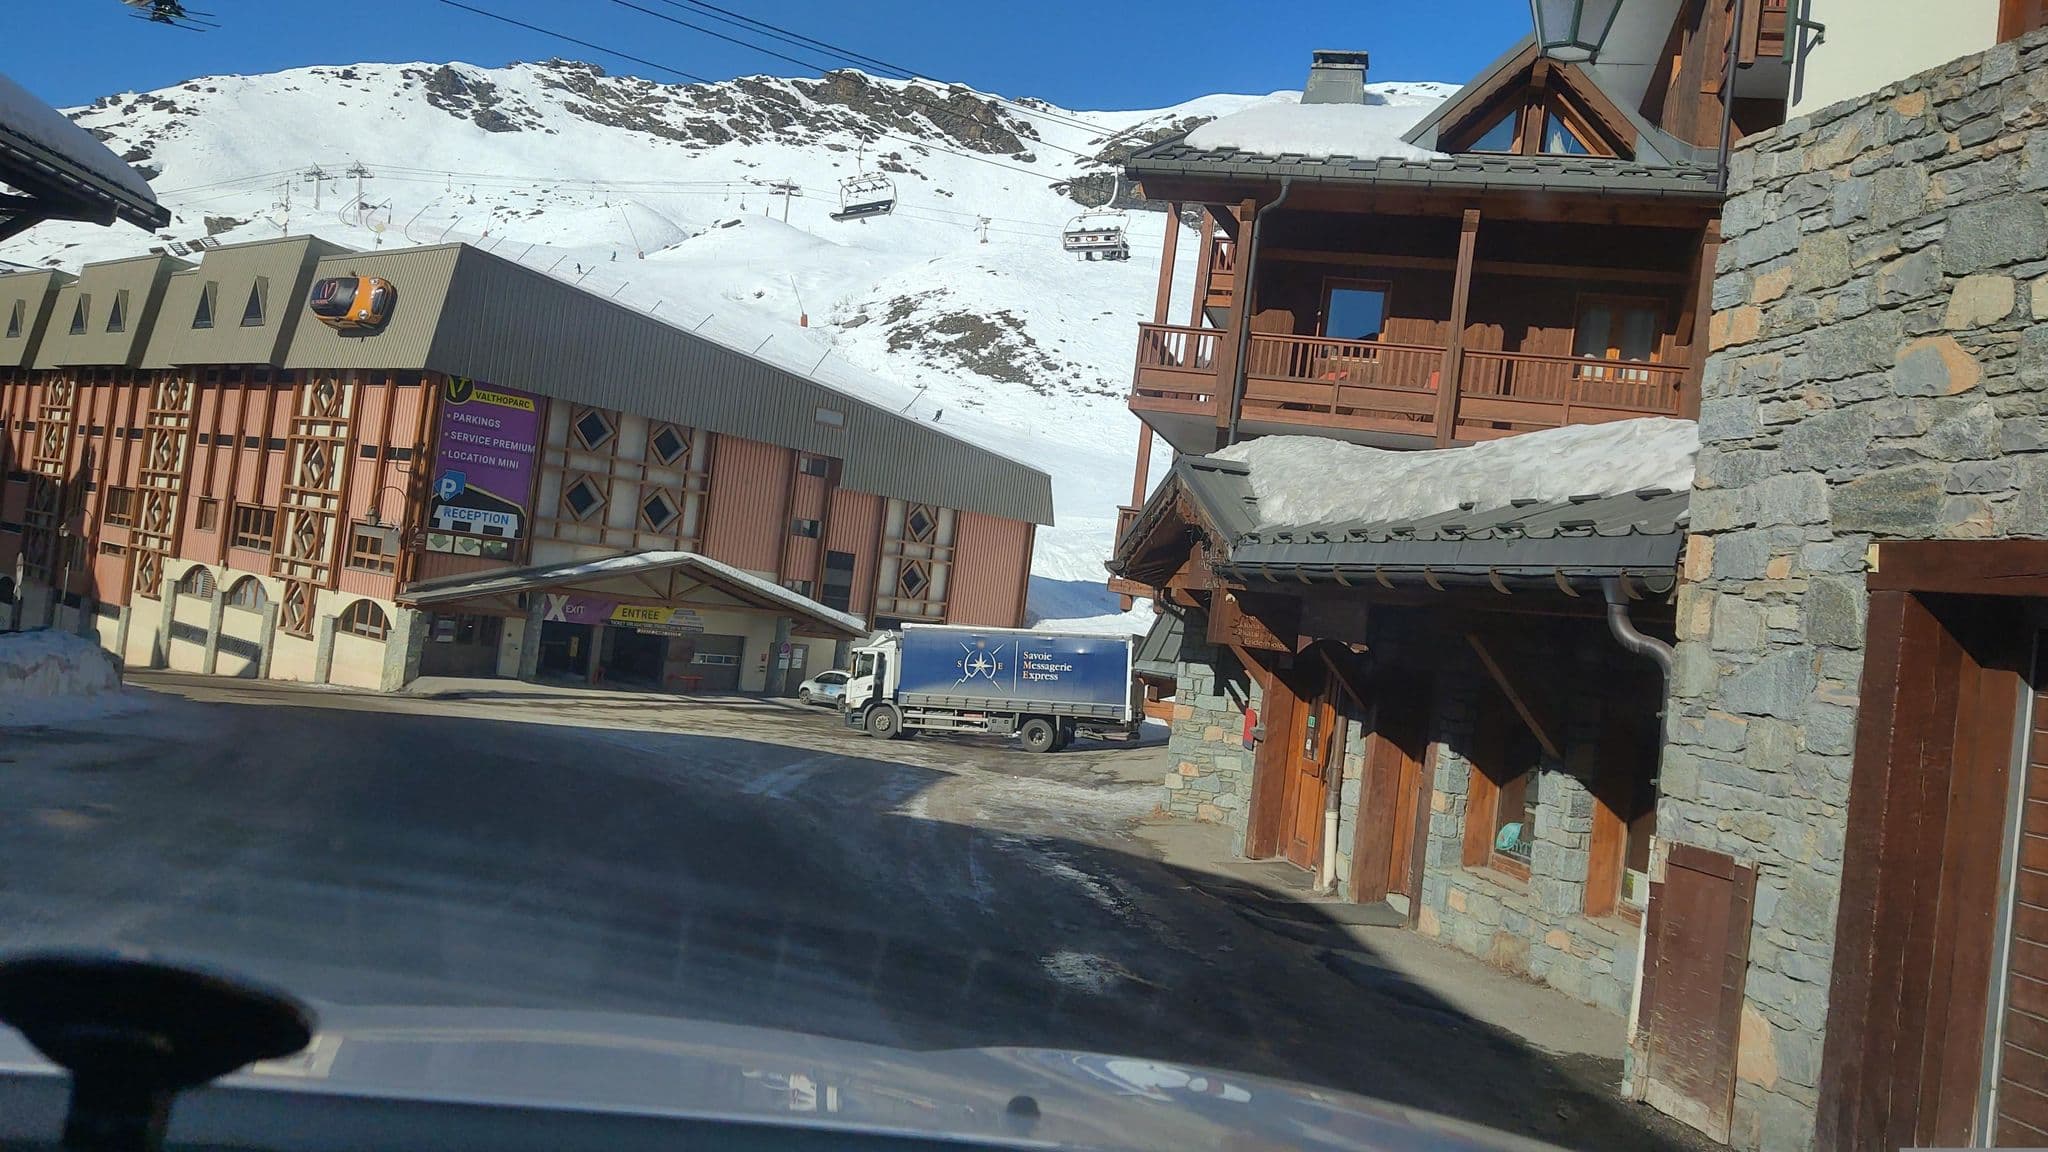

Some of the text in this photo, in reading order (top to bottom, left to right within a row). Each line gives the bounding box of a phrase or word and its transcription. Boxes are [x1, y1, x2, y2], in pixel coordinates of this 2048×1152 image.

[475, 391, 530, 409] VALTHOPARC
[453, 412, 501, 428] PARKINGS
[450, 431, 536, 454] SERVICE PREMIUM
[448, 449, 519, 469] LOCATION MINI
[440, 478, 457, 500] P
[443, 506, 509, 525] RECEPTION
[621, 607, 661, 620] ENTREE
[1023, 651, 1053, 661] Savoie
[1023, 661, 1073, 672] Messagerie
[1023, 670, 1059, 682] Express
